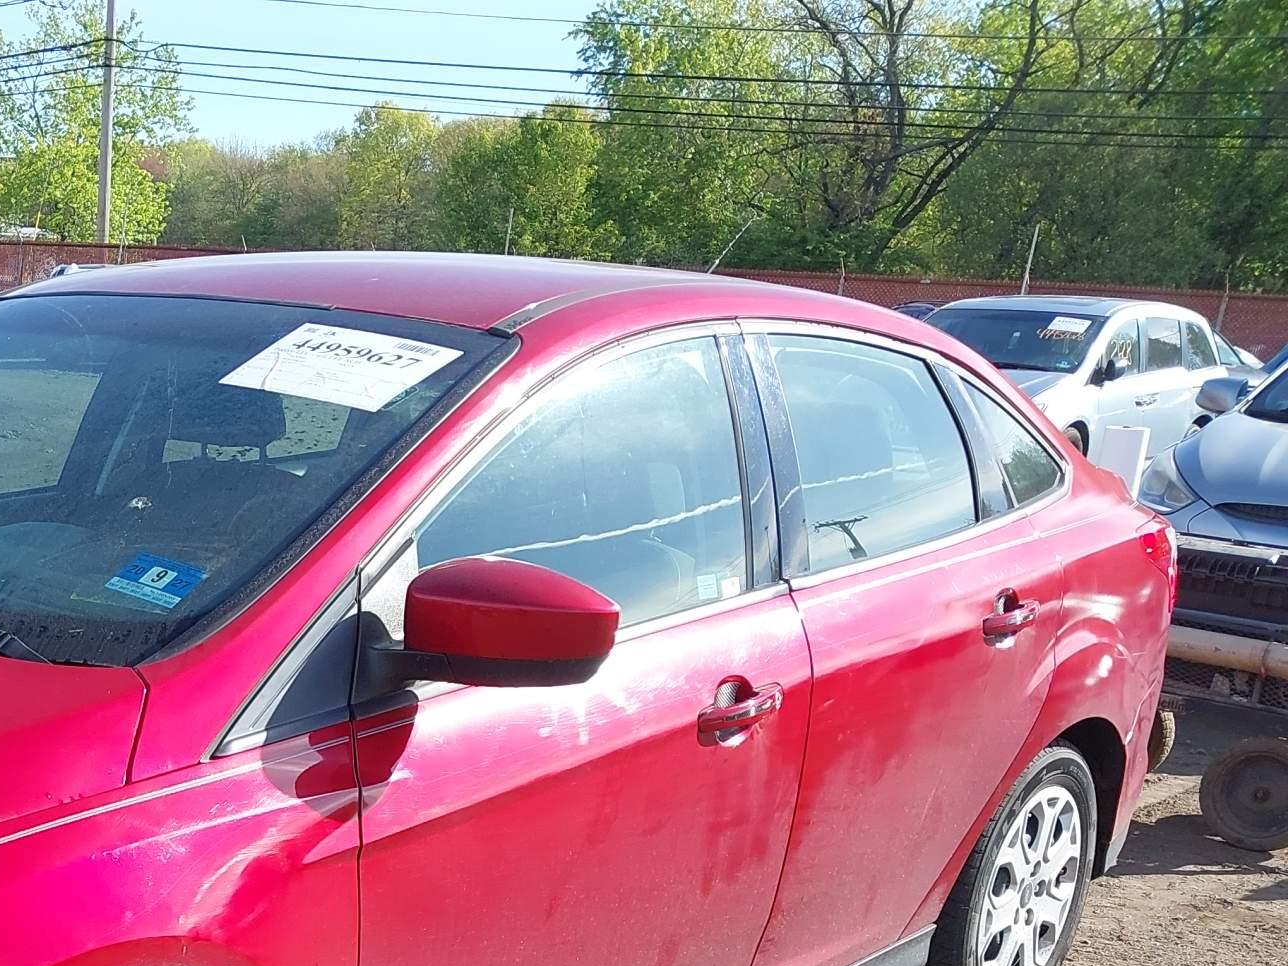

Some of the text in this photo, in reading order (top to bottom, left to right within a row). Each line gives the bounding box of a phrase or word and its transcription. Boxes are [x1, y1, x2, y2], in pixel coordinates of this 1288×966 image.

[292, 338, 423, 369] 44959627
[128, 564, 145, 576] 20
[151, 569, 168, 583] 9
